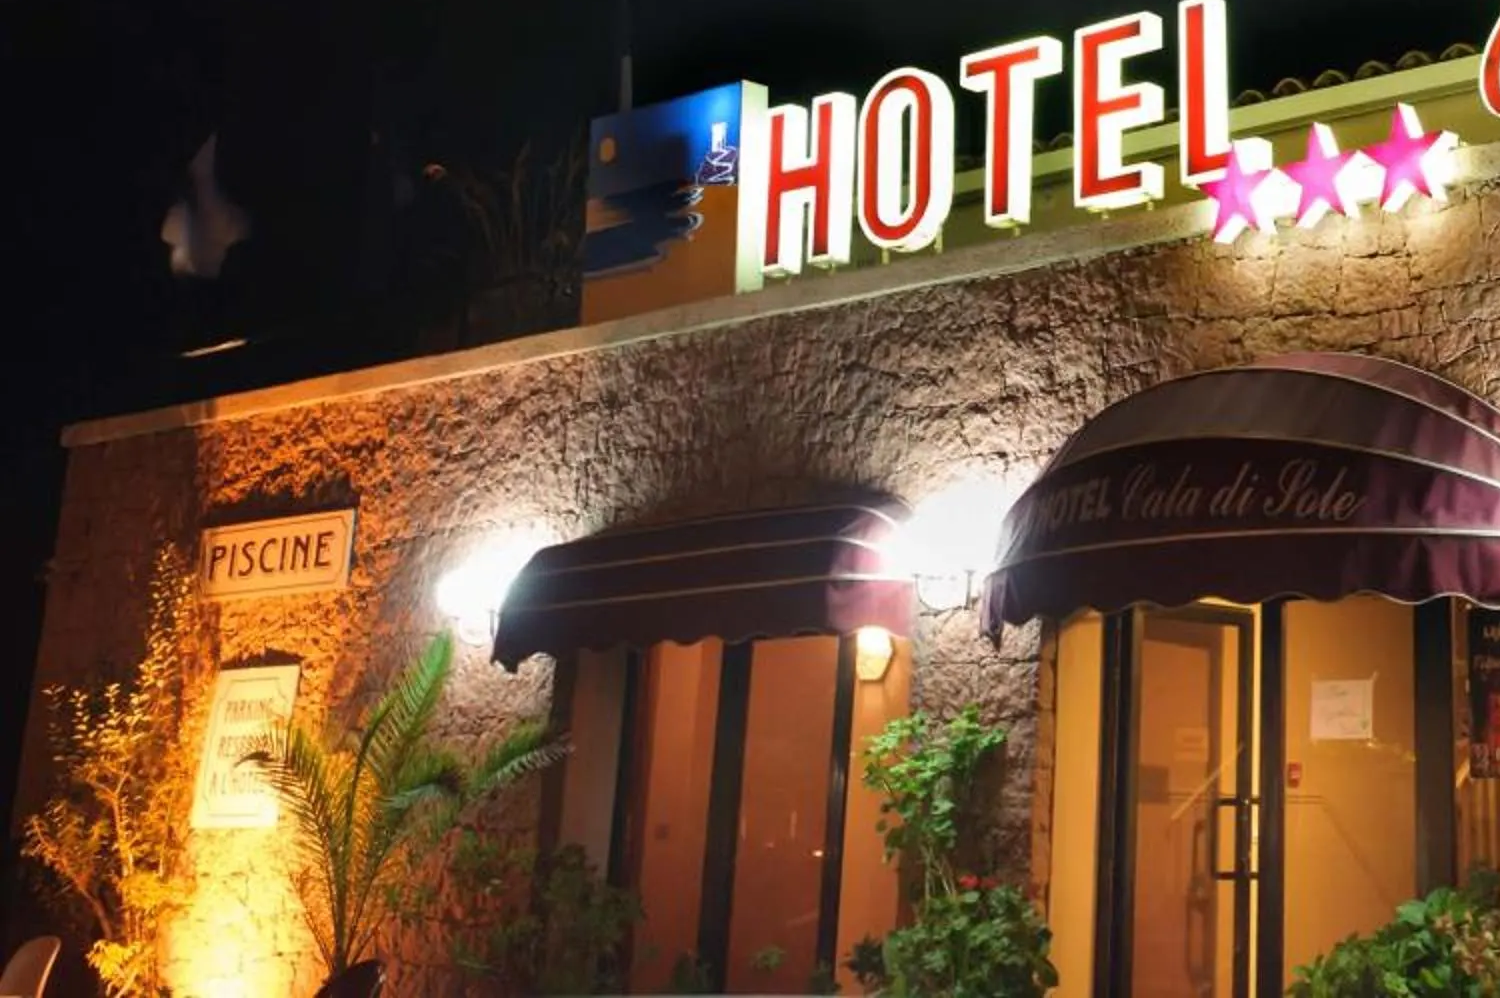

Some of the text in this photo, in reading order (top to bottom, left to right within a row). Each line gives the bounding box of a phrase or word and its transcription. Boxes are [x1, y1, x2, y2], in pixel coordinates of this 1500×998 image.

[1121, 462, 1201, 522] Cala
[1209, 460, 1257, 519] di
[1263, 458, 1368, 522] Sole
[208, 530, 336, 581] PISCINE
